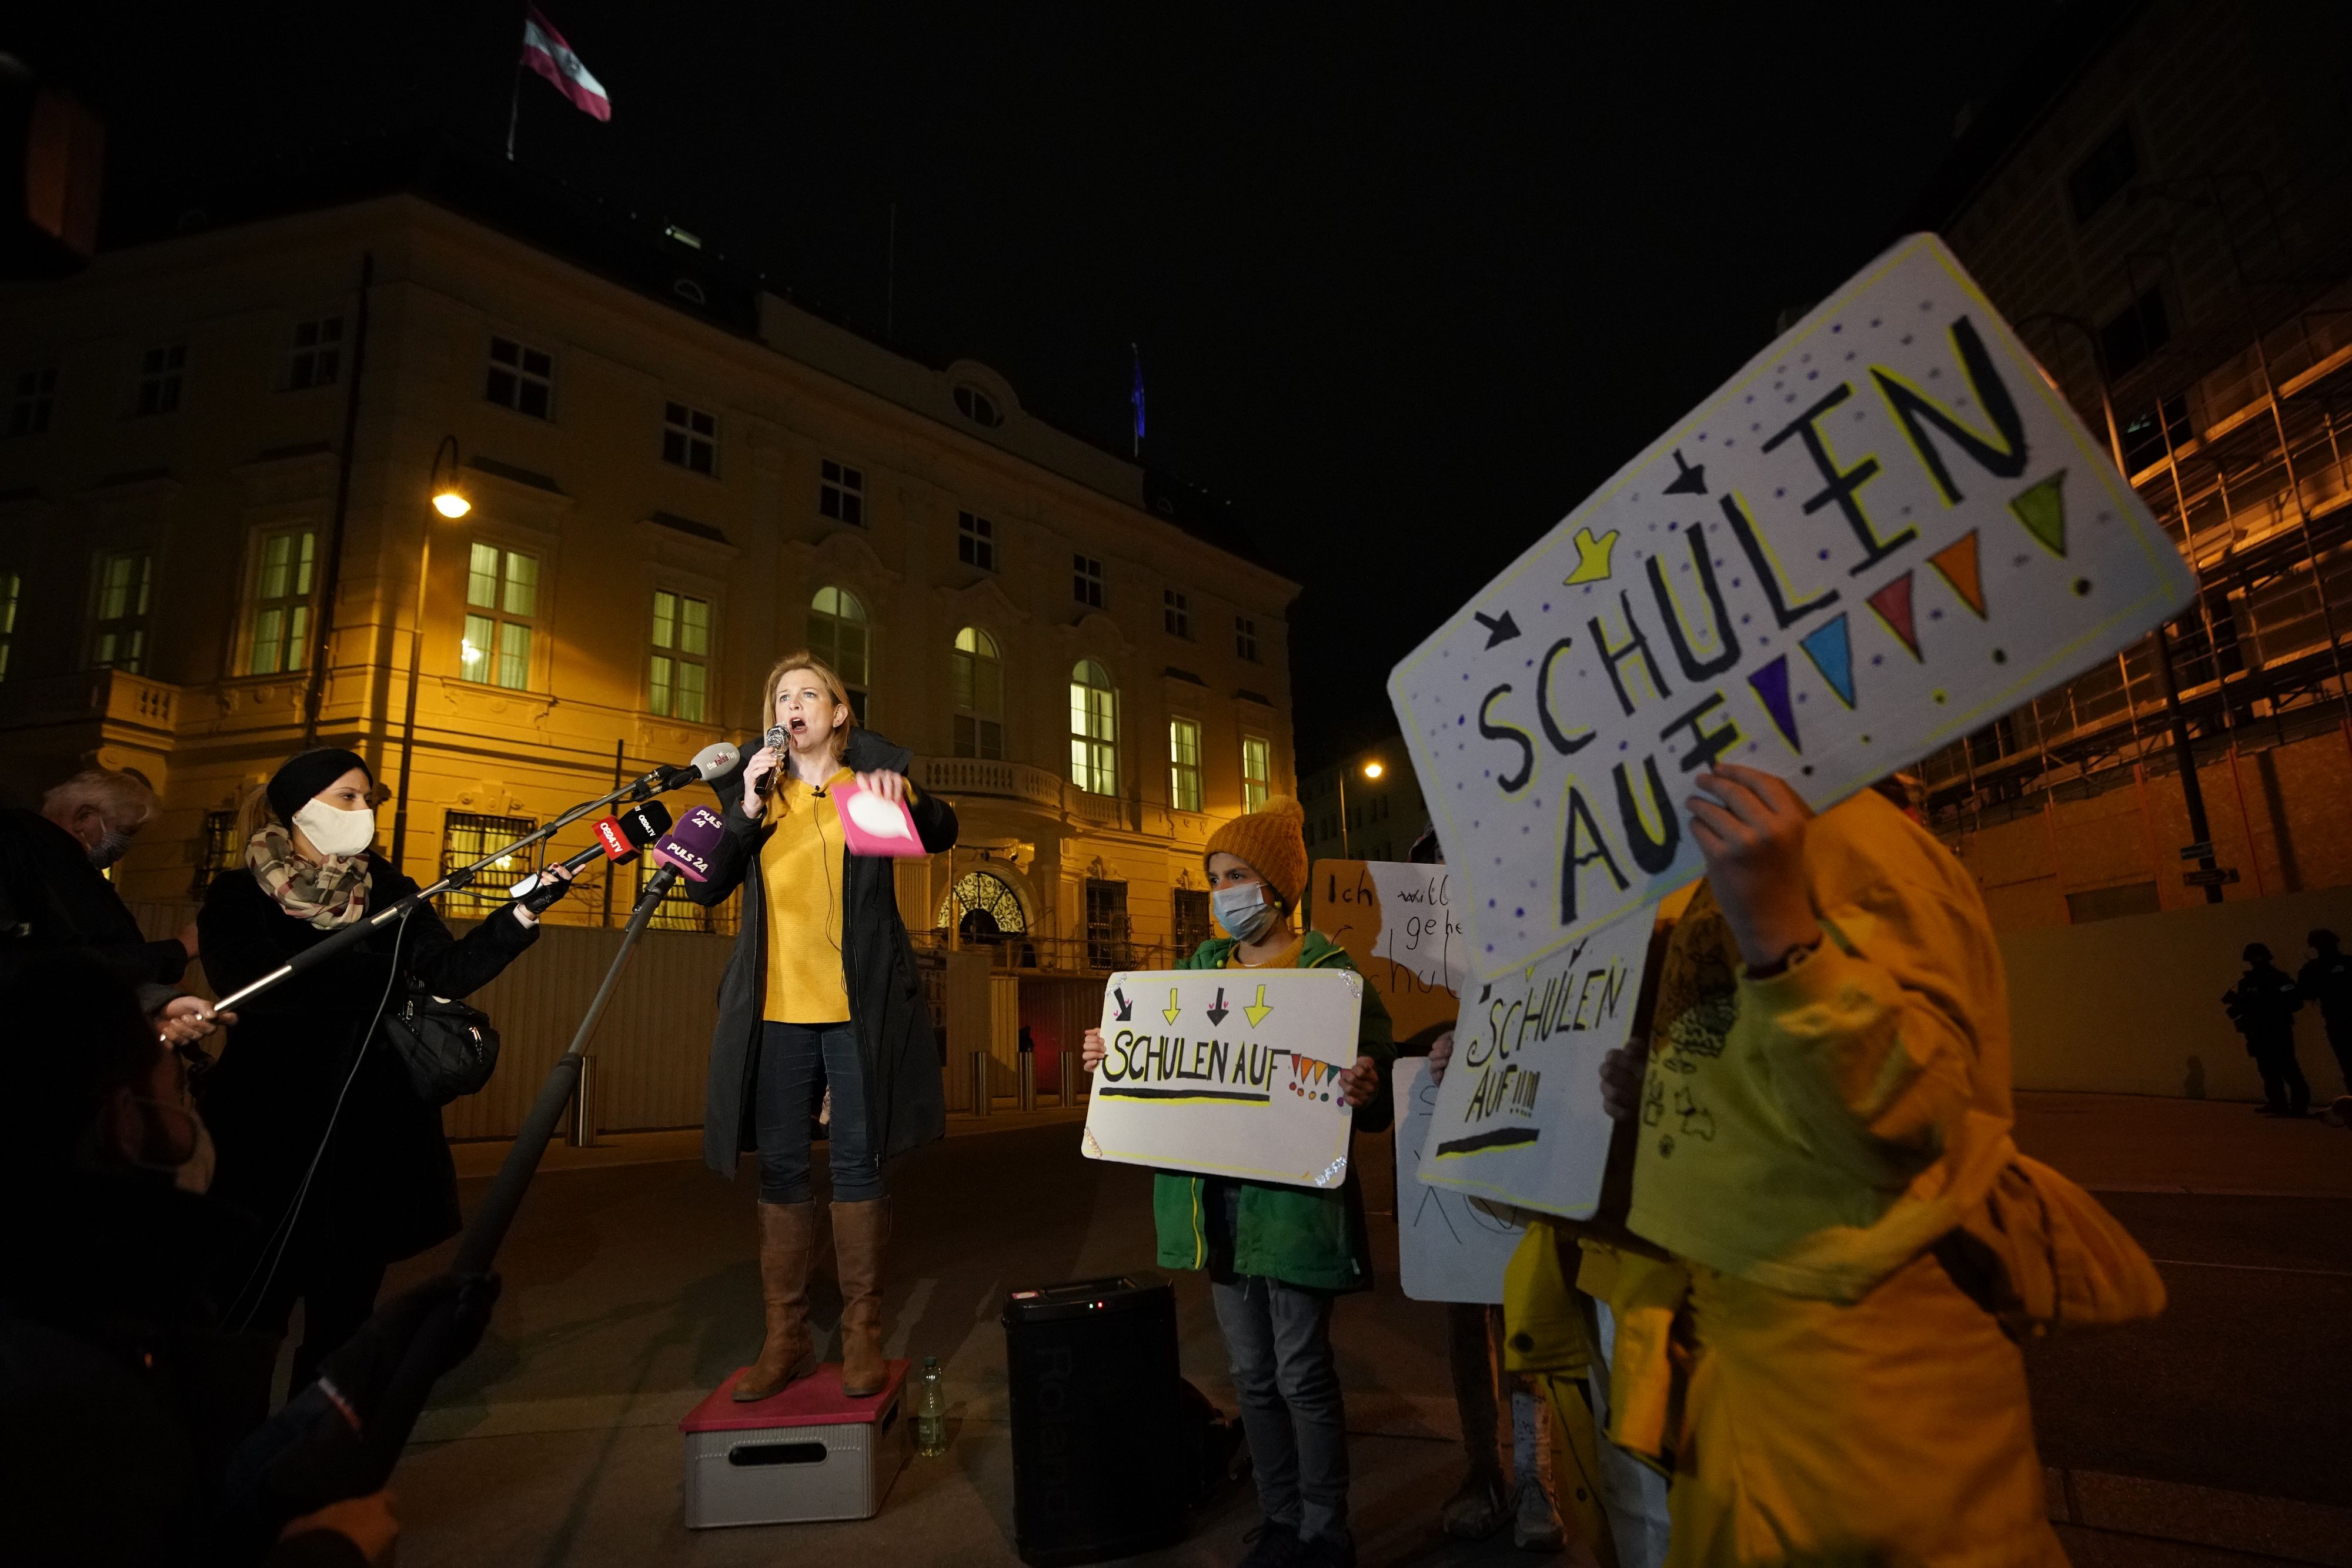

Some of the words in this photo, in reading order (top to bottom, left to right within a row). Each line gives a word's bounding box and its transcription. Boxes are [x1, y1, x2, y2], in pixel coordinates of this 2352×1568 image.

[1478, 315, 2027, 794] SCHULEN
[696, 809, 723, 829] PULS
[1561, 691, 1741, 926] AUF
[666, 842, 694, 862] PULS
[692, 857, 709, 873] 24
[1328, 869, 1373, 906] Ich
[1397, 874, 1449, 906] will
[1406, 909, 1463, 950] gehe
[1466, 966, 1627, 1067] SCHULEN
[1101, 1030, 1229, 1084] SCHULEN
[1232, 1041, 1291, 1091] AUF
